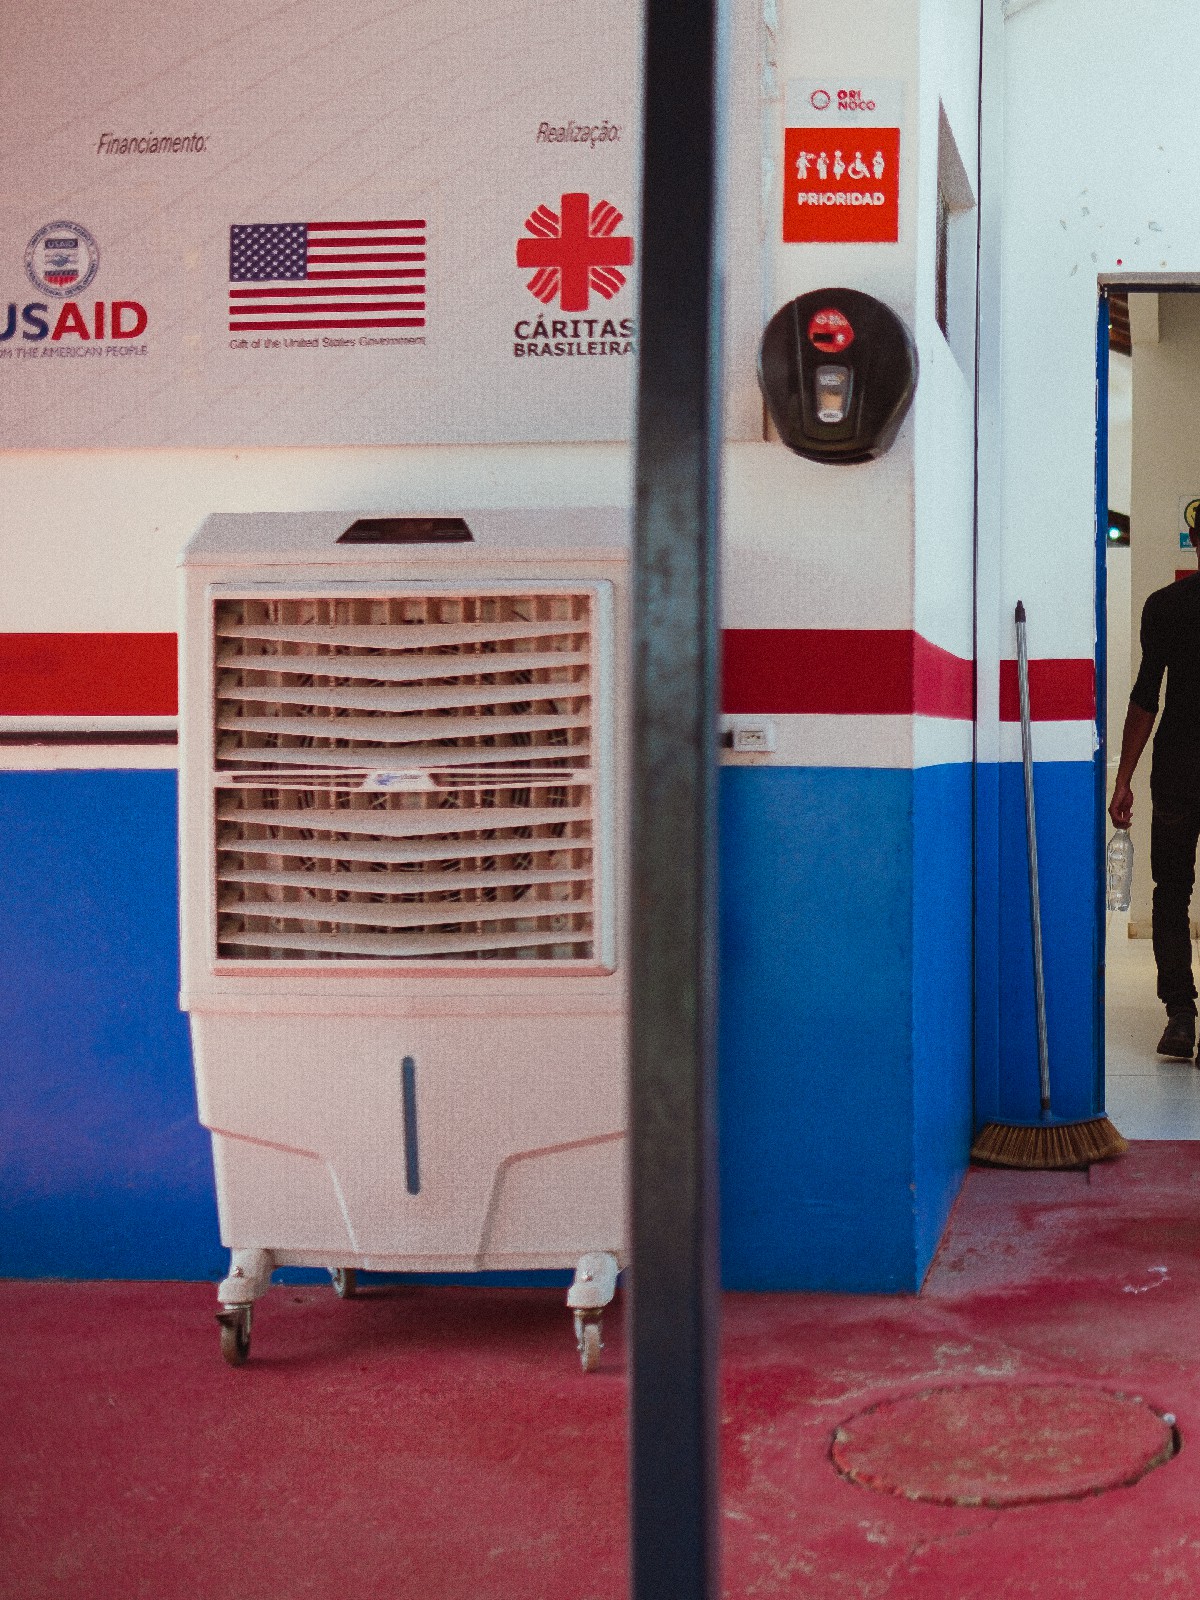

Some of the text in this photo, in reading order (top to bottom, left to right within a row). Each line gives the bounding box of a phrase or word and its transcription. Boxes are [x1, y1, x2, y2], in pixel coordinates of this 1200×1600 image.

[837, 89, 861, 101] ORI
[838, 101, 876, 111] NOCO
[97, 130, 210, 154] Financiamento:
[797, 191, 885, 206] PRIORIDAD
[514, 313, 634, 340] CÁRITAS
[264, 337, 281, 349] the
[284, 337, 320, 349] United
[322, 336, 356, 348] States
[359, 336, 427, 347] Government
[514, 341, 634, 357] BRASILEIRA
[16, 346, 38, 358] THE
[41, 345, 103, 358] AMERICAN
[105, 344, 149, 357] PEOPLE
